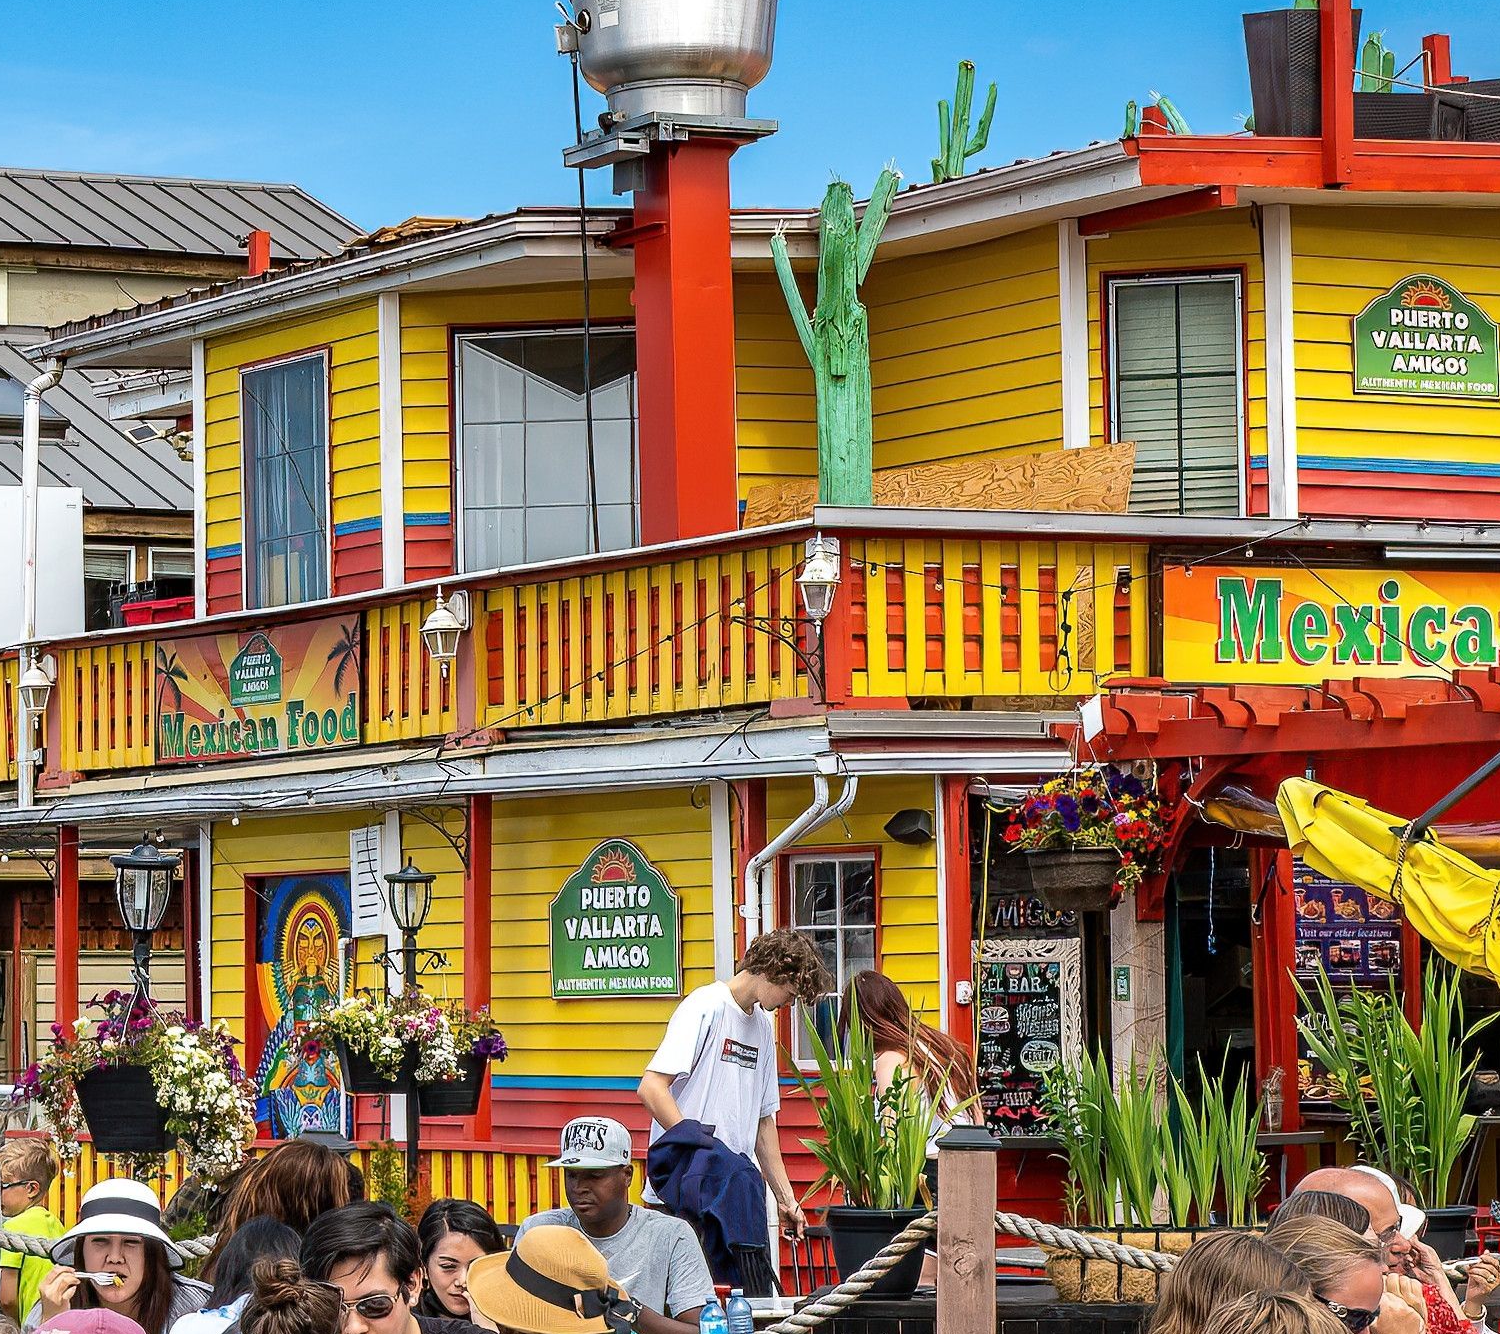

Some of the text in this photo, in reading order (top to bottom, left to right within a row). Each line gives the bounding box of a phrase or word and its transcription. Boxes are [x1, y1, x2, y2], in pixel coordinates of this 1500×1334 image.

[1390, 308, 1469, 330] PUERTO
[1371, 330, 1483, 353] VALLARTA
[1391, 354, 1468, 376] AMIGOS
[1467, 381, 1495, 393] FOOD
[161, 690, 359, 758] Mexican Food
[581, 885, 650, 910] PUERTO
[565, 914, 664, 940] VALLARTA
[583, 945, 650, 969] AMIGOS
[650, 976, 673, 989] FOOD
